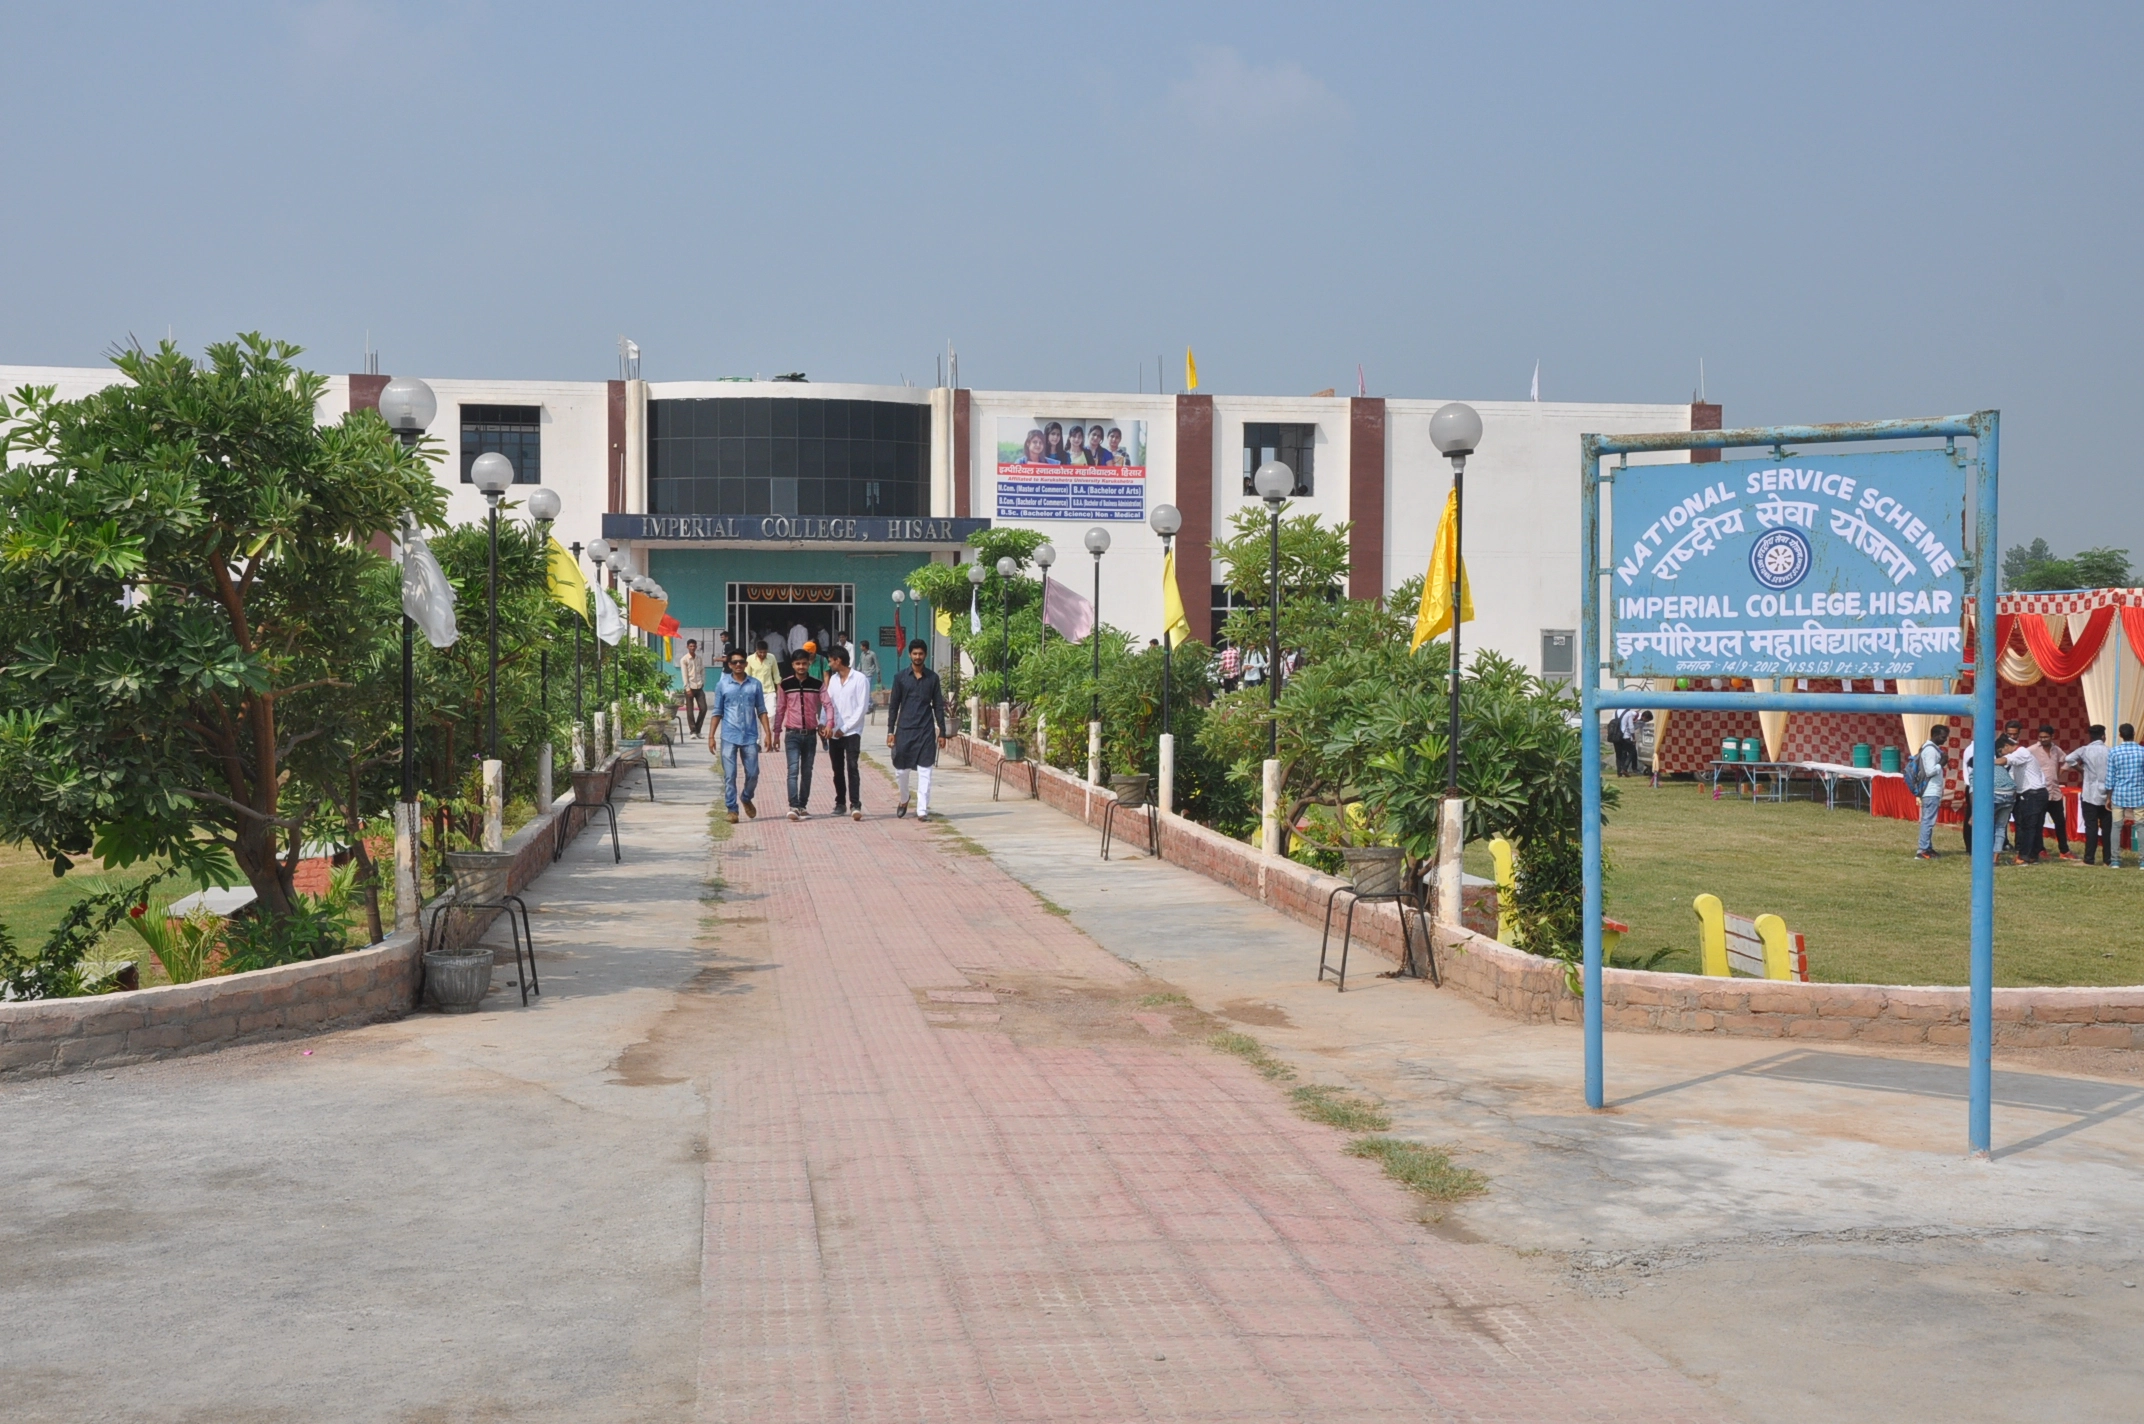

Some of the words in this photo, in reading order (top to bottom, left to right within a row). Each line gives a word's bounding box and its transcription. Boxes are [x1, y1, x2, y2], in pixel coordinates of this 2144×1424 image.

[1121, 467, 1142, 477] हिसार
[1041, 486, 1068, 495] Commerce)
[1073, 486, 1086, 494] B.A.
[1087, 486, 1117, 495] (Bachelor
[1126, 487, 1142, 496] Arts)
[1020, 510, 1053, 518] (Bachelor
[642, 517, 740, 538] IMPERIAL
[888, 520, 953, 540] HISAR
[1616, 482, 1736, 586] NATIONAL
[1746, 468, 1857, 501] SERVICE
[1858, 488, 1957, 578] SCHEME
[1651, 508, 1744, 580] राष्ट्रीय
[1755, 493, 1820, 528] सेवा
[1830, 508, 1917, 586] योजना
[1619, 595, 1738, 620] IMPERIAL
[1616, 622, 1745, 660] इम्पीरियल
